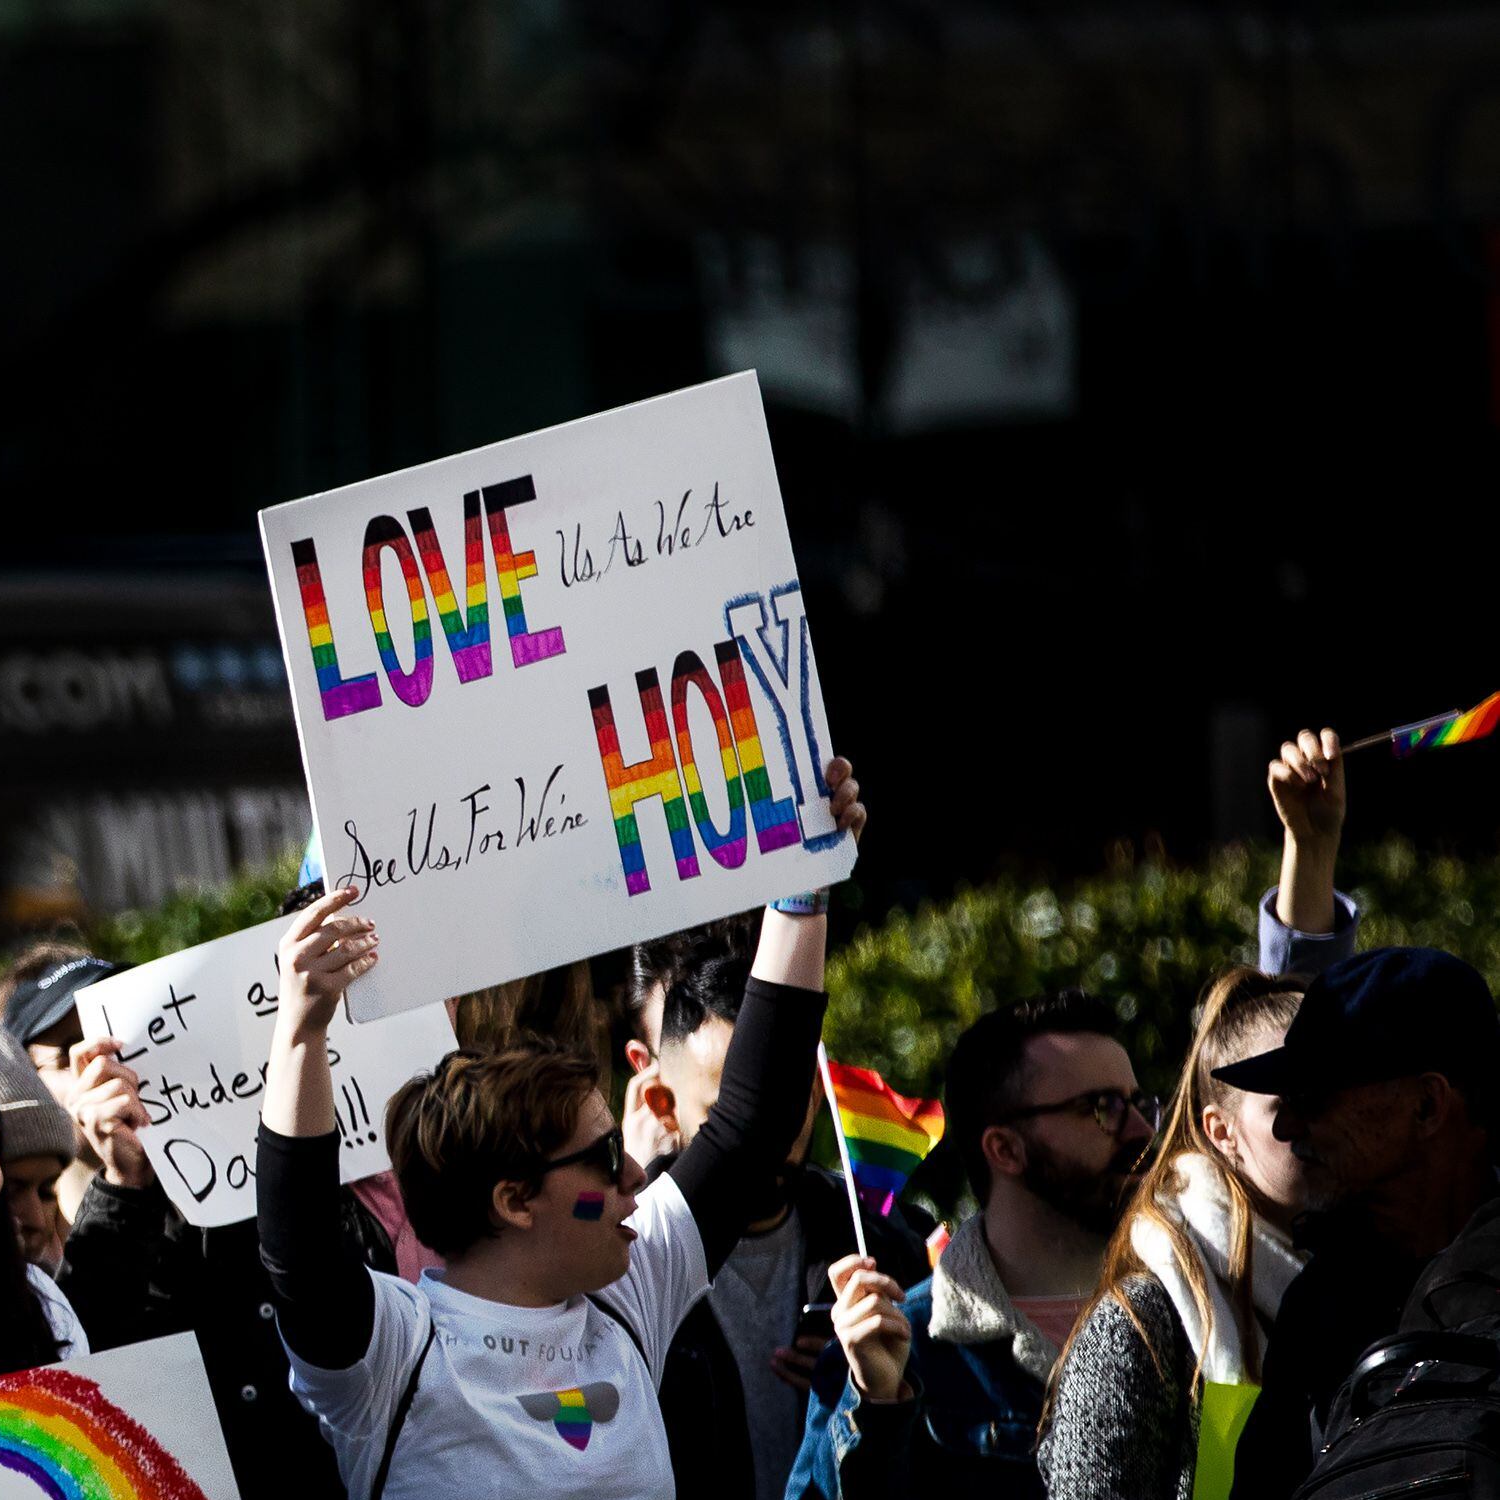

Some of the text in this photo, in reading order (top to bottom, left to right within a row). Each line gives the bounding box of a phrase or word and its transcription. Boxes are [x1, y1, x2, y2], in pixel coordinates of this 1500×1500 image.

[291, 474, 567, 722] LOVE
[556, 523, 601, 587] Us,
[604, 511, 648, 567] As
[653, 489, 692, 555] We
[696, 481, 755, 546] Are
[336, 819, 406, 906] See
[407, 803, 462, 875] Us,
[460, 784, 507, 864] For
[514, 764, 588, 848] We're
[589, 580, 850, 896] HOLY
[102, 984, 197, 1064] Let
[138, 1037, 341, 1126] Studes
[163, 1077, 378, 1203] Da!!!
[483, 1333, 530, 1357] OUT
